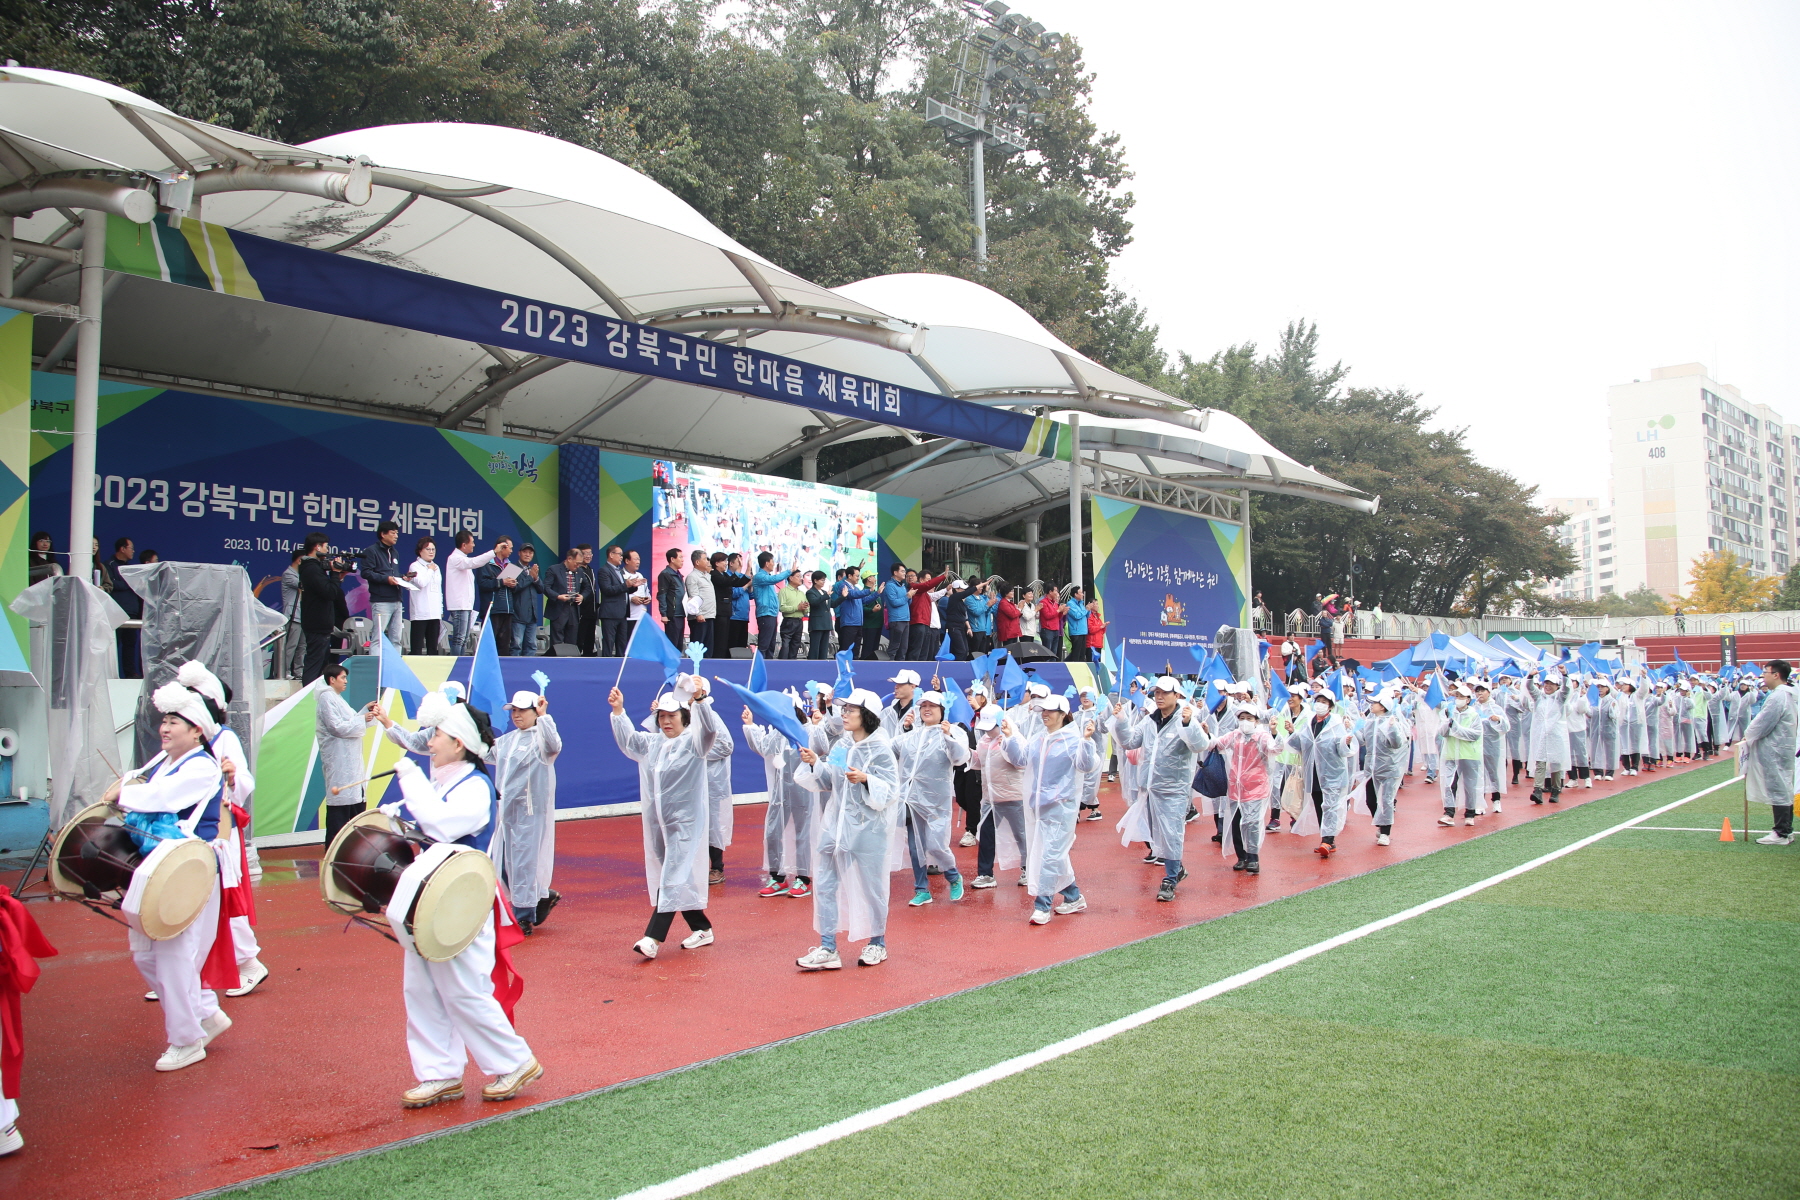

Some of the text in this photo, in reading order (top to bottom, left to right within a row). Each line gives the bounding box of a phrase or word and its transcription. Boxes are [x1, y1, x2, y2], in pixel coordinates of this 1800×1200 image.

[501, 299, 901, 416] 2023 강북구민 한마음 체육대회
[1636, 430, 1658, 442] LH
[1648, 446, 1666, 459] 408
[511, 452, 538, 483] 강북
[178, 481, 295, 525] 강북구민
[302, 492, 382, 532] 한마음
[388, 500, 483, 540] 체육대회
[224, 538, 253, 551] 2023.
